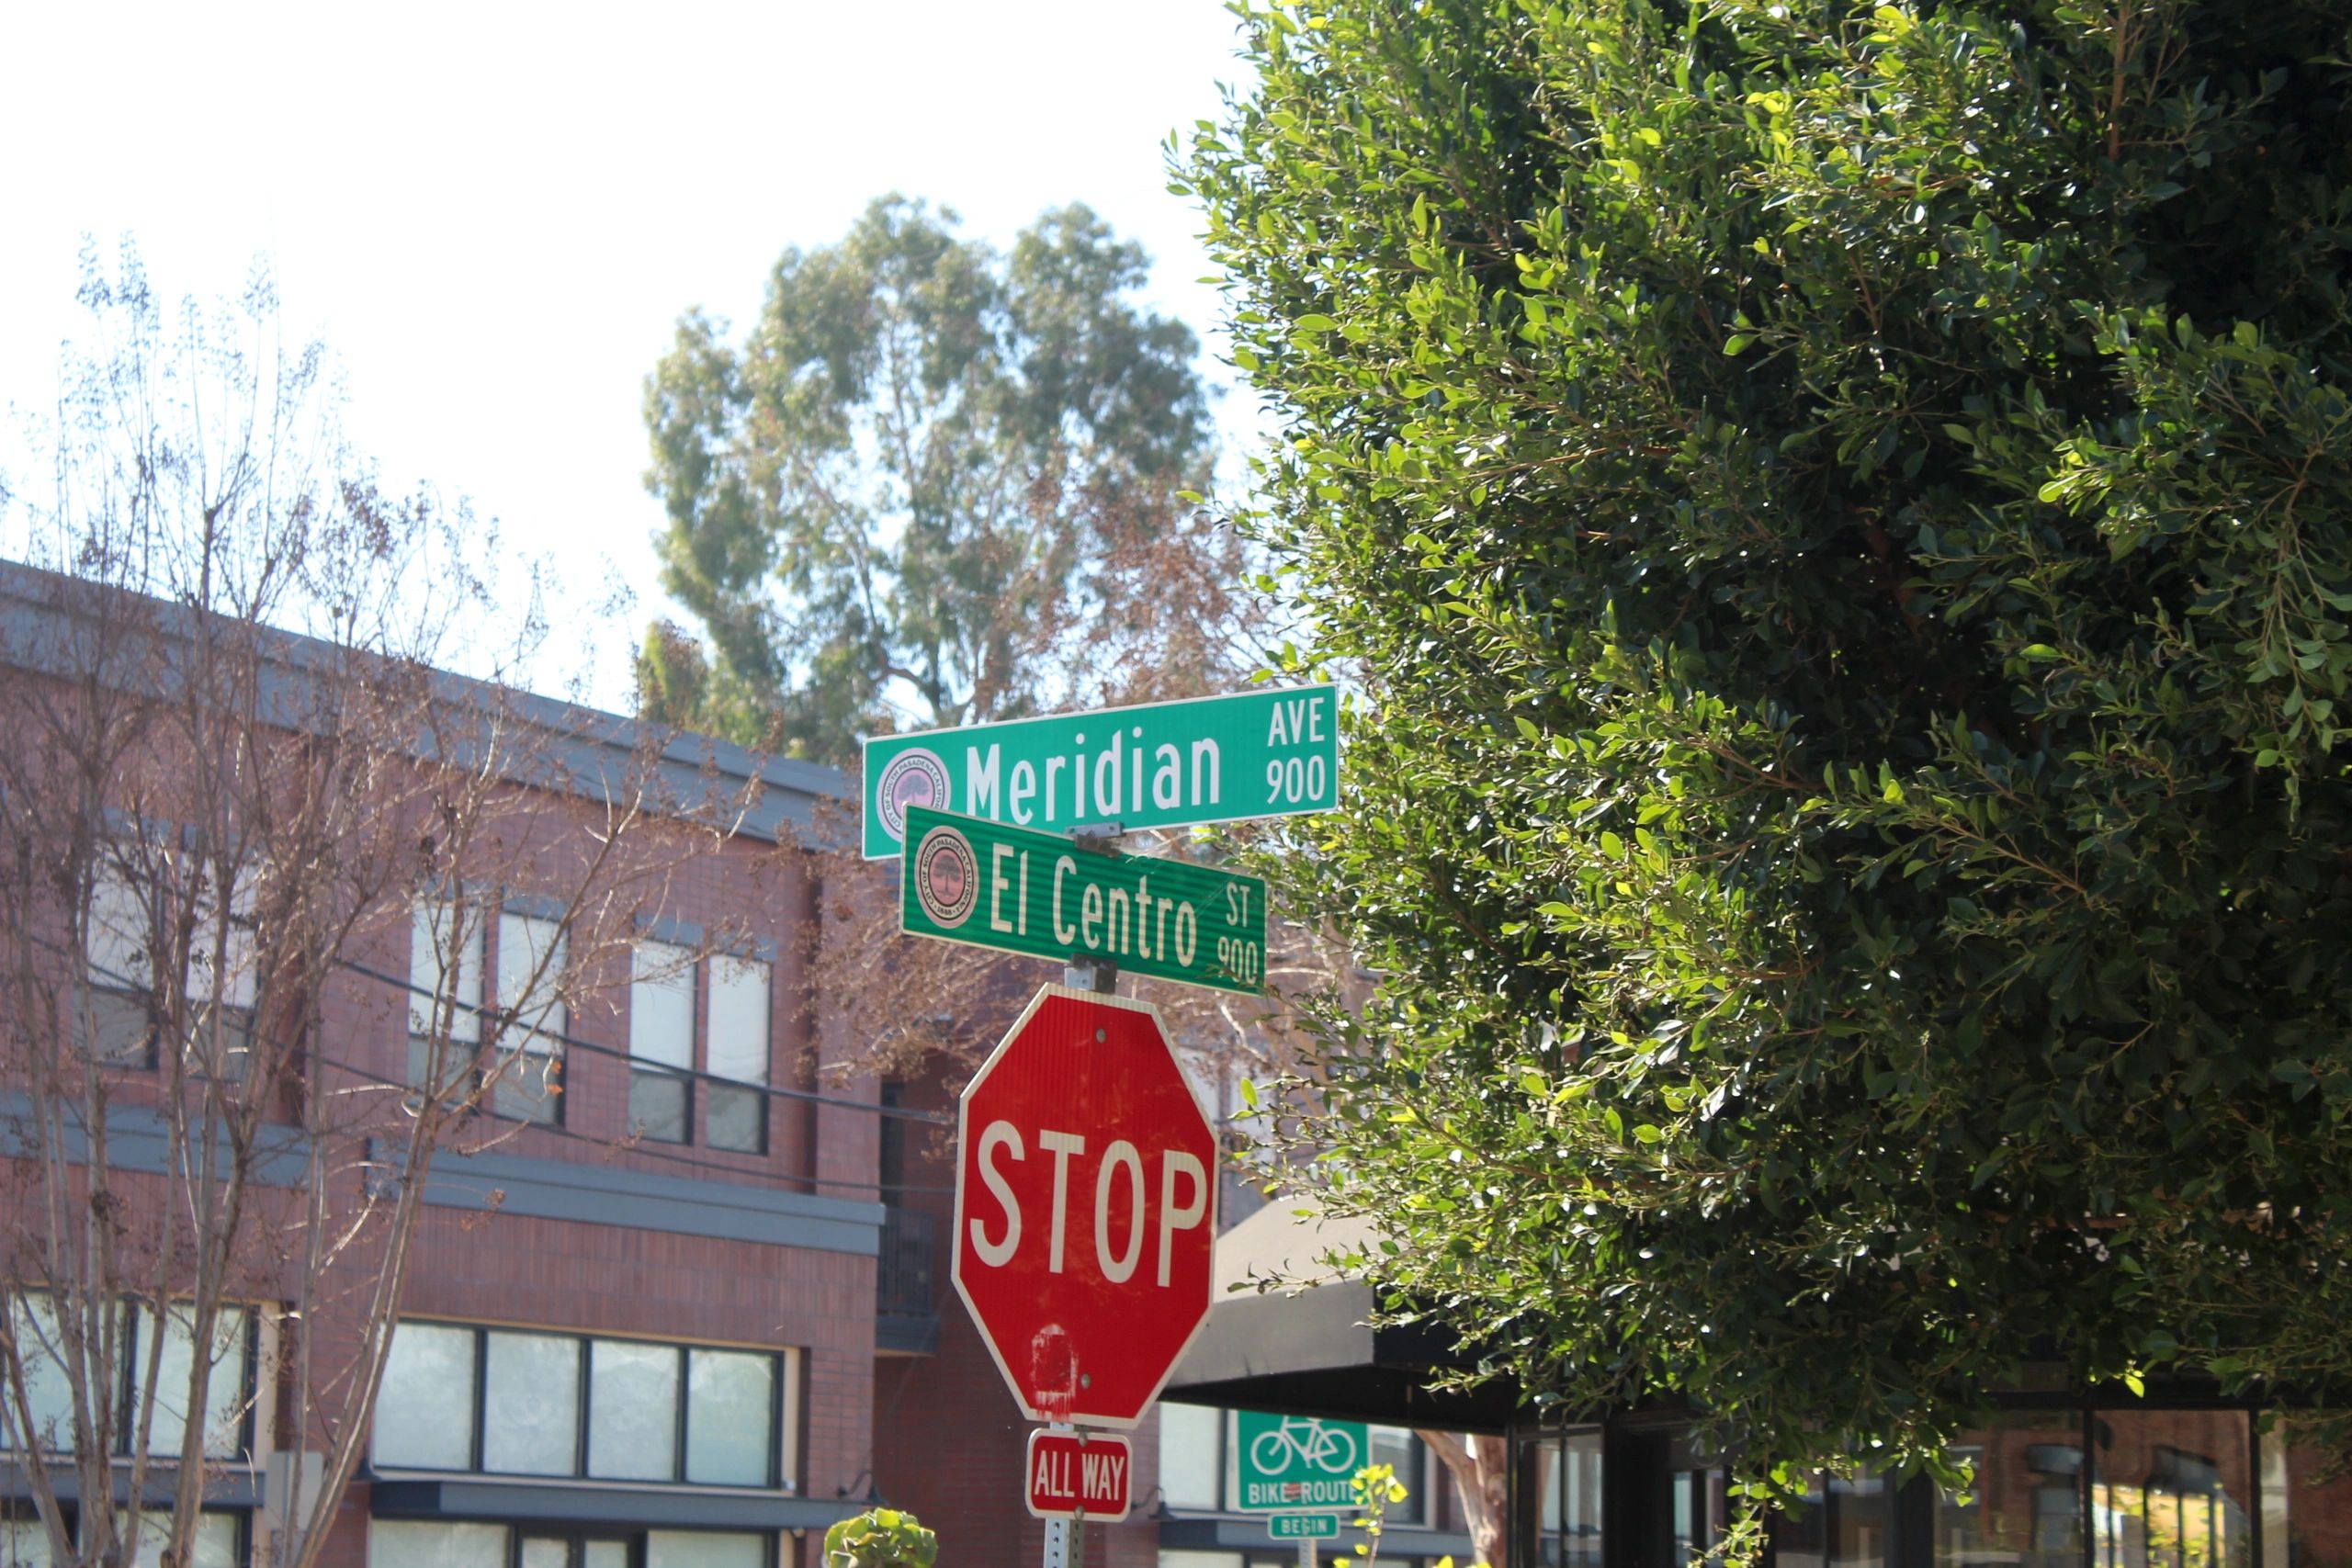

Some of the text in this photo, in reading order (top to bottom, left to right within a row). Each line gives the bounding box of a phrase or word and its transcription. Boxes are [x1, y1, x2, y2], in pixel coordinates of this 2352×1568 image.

[1268, 697, 1325, 747] AVE
[885, 771, 899, 796] SOUTH
[898, 760, 933, 773] PASADENA
[967, 727, 1219, 825] Meridian
[1267, 755, 1325, 805] 900
[885, 798, 891, 810] OF
[922, 839, 972, 912] CITY OF SOUTH PASADENA CALIFORNIA
[990, 842, 1197, 967] El Centro
[1226, 882, 1250, 928] ST
[1217, 936, 1258, 985] 900
[970, 1120, 1207, 1287] STOP
[1035, 1450, 1125, 1501] ALL WAY
[1249, 1480, 1357, 1505] BIKE ROUTE
[1281, 1517, 1328, 1536] BEGIN
